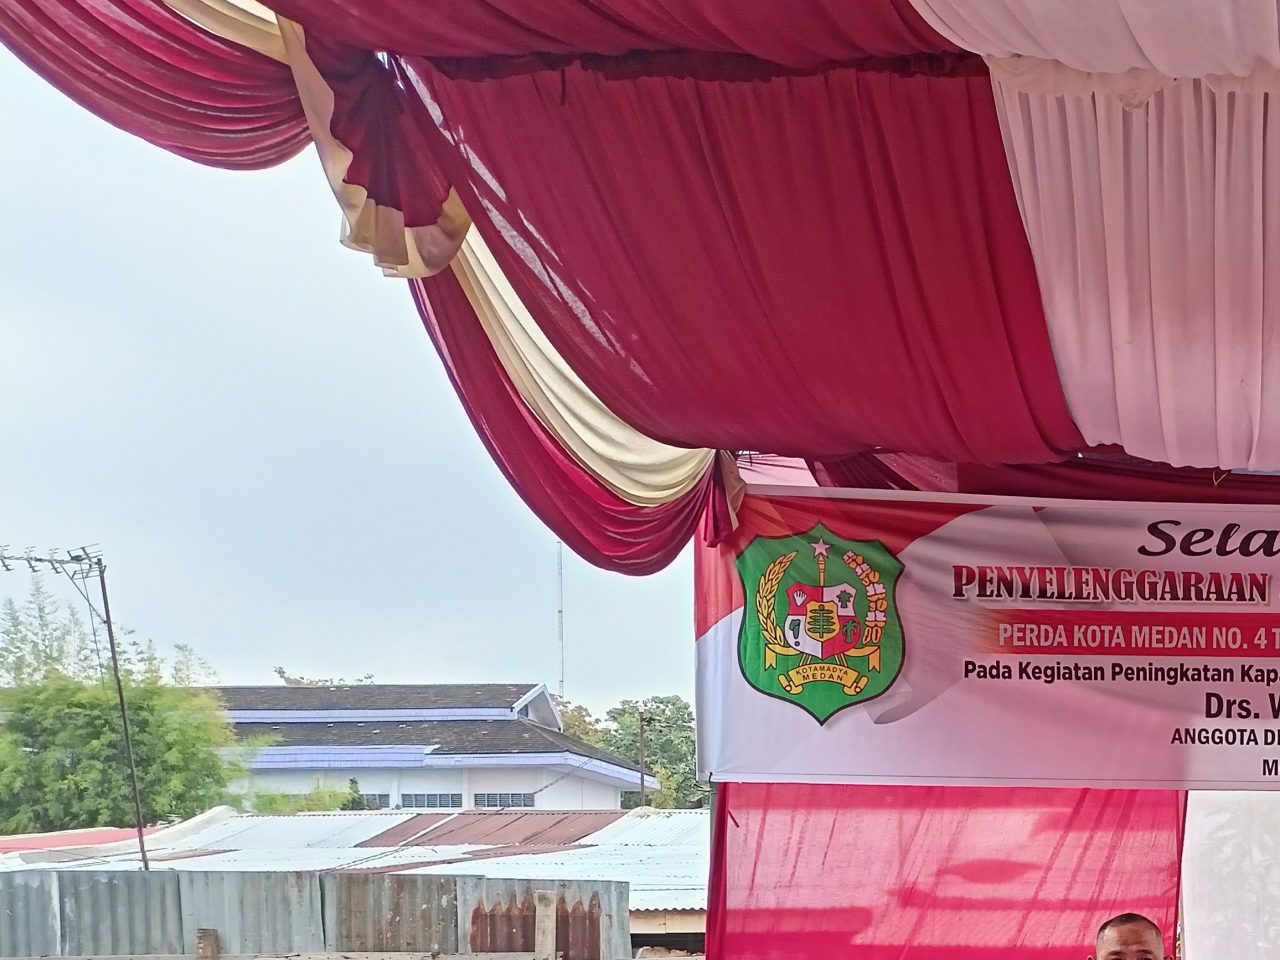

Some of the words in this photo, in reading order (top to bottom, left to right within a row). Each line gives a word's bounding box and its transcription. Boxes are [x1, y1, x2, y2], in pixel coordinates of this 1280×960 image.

[951, 564, 1270, 602] PENYELENGGARAAN
[998, 623, 1068, 647] PERDA
[1073, 624, 1126, 648] KOTA
[1131, 625, 1206, 649] MEDAN
[1212, 626, 1249, 649] NO.
[1253, 627, 1268, 650] 4
[795, 665, 848, 676] KOTAMADYA
[802, 672, 843, 682] MEDAN
[963, 660, 1013, 680] Pada
[1018, 661, 1105, 684] Kegiatan
[1111, 662, 1234, 686] Peningkatan
[1204, 692, 1260, 720] Drs.
[1170, 727, 1259, 746] ANGGOTA
